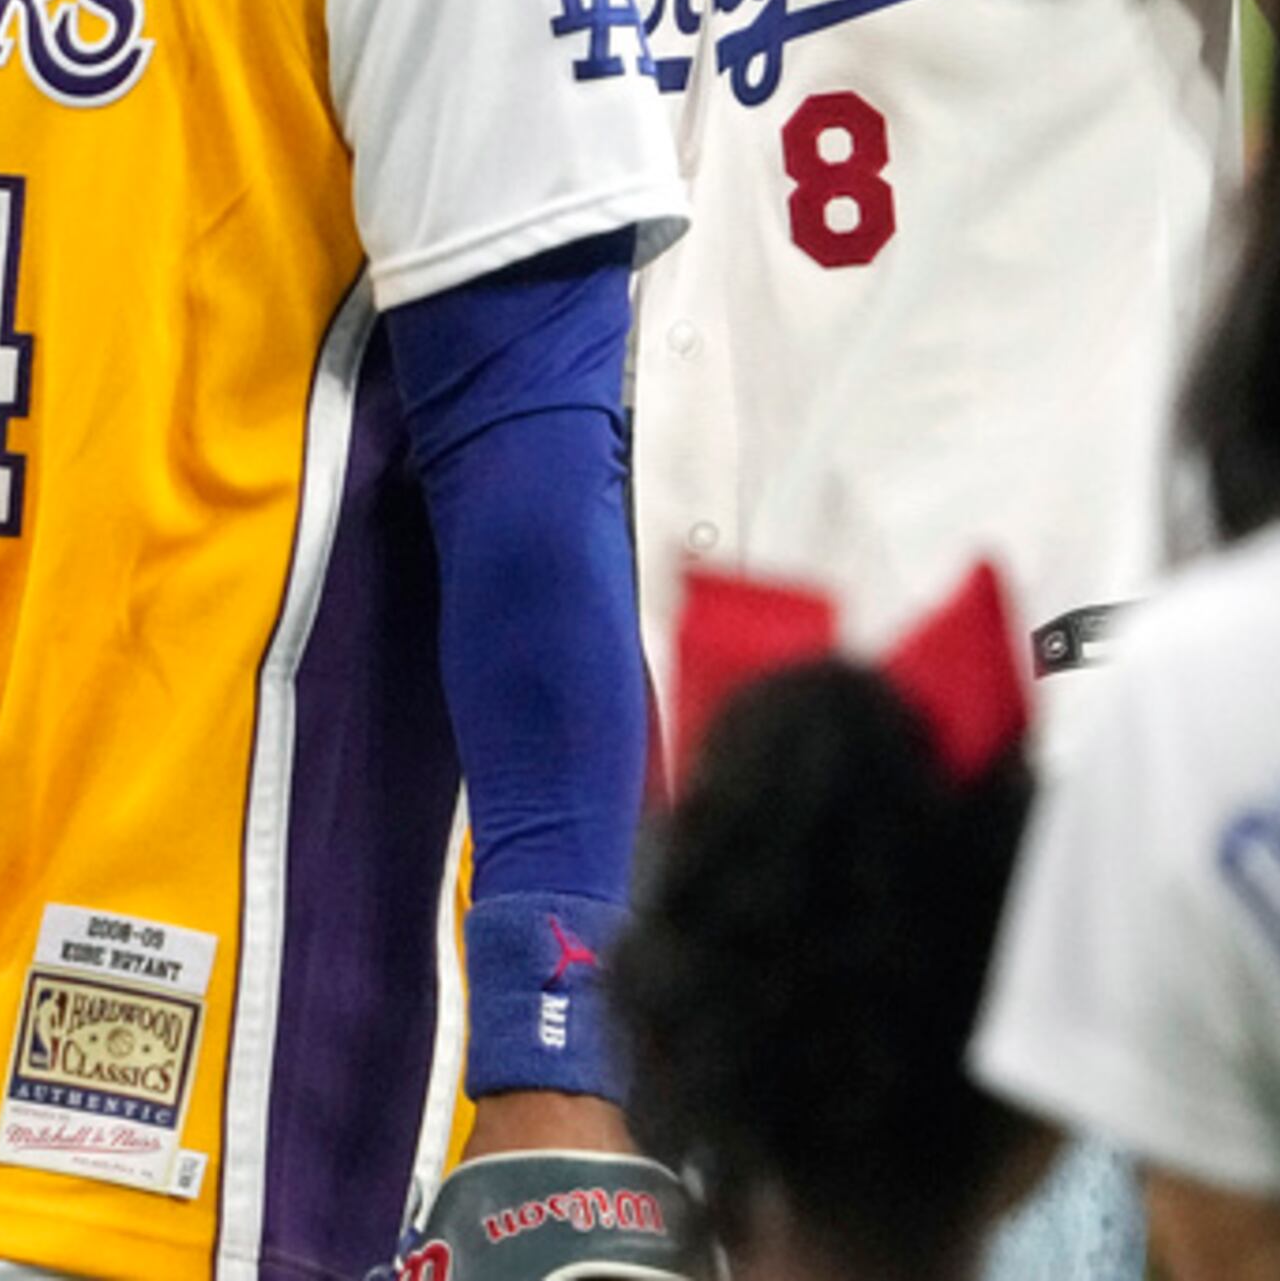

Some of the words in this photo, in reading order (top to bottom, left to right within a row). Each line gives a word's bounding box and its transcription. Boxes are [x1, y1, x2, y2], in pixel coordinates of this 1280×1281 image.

[781, 91, 896, 268] 8
[62, 1039, 175, 1094] CLASSICS
[16, 1083, 172, 1124] AUTHENTIC
[483, 1186, 667, 1244] Wilson
